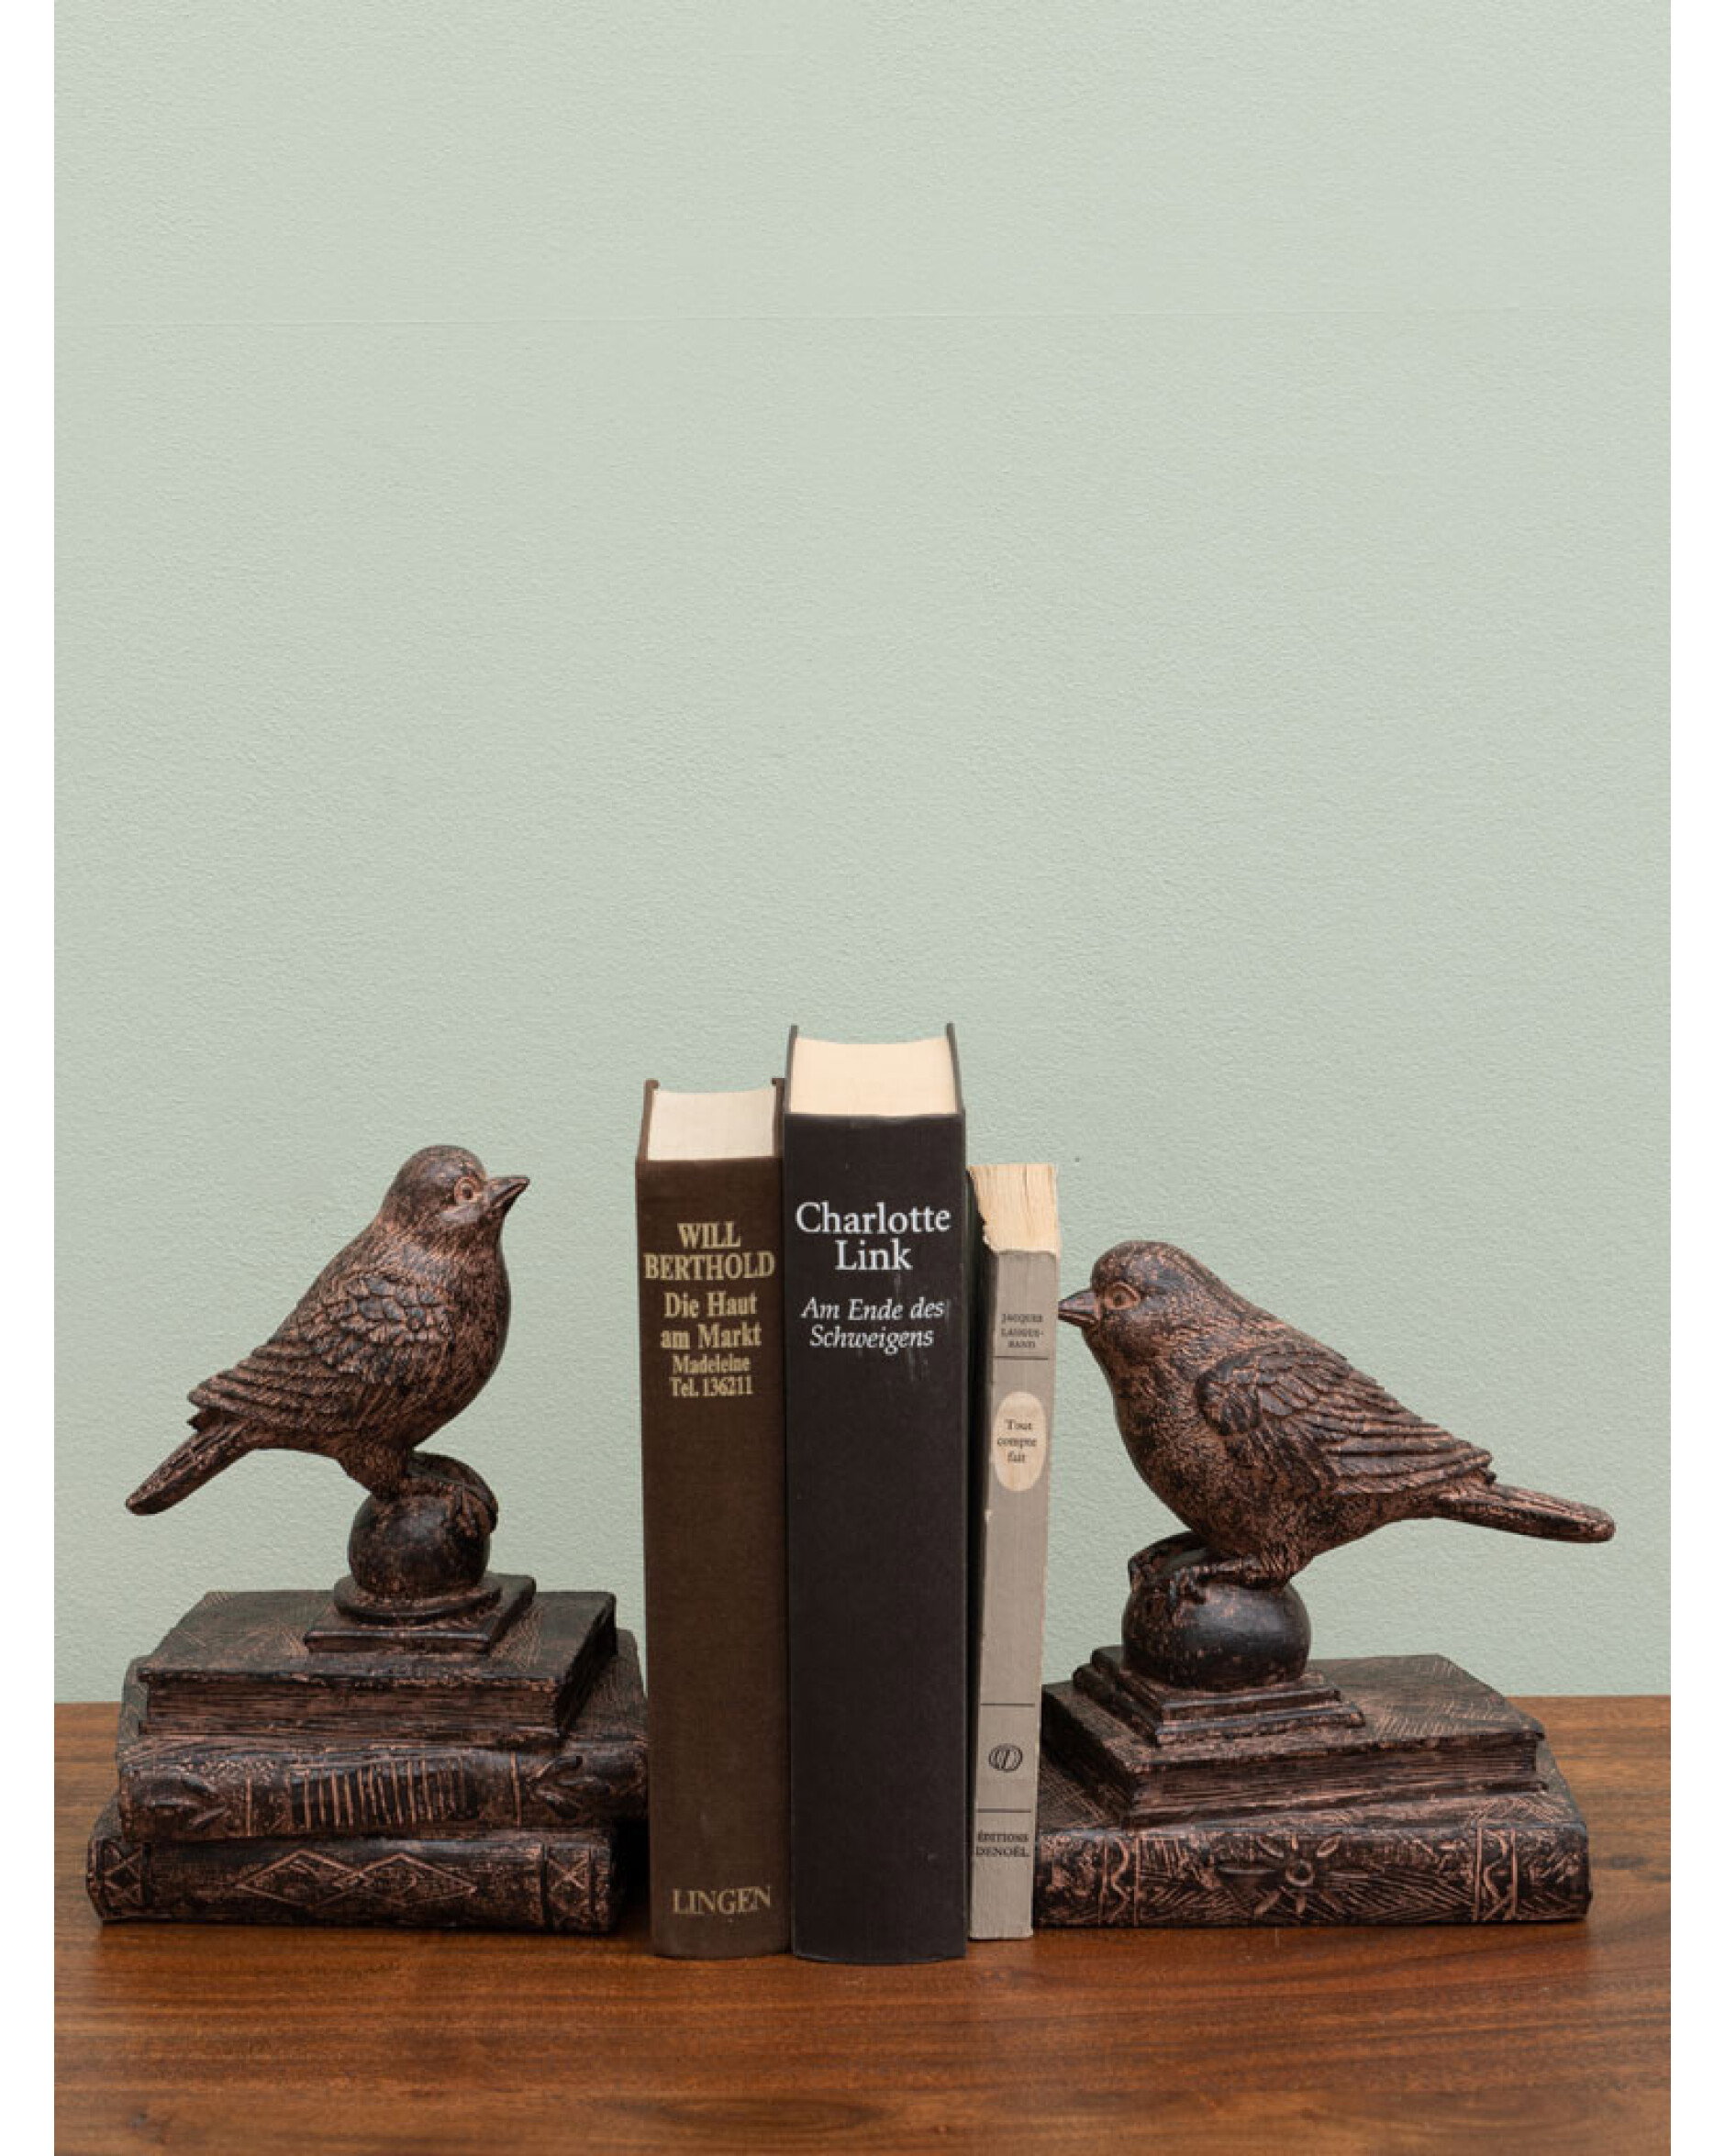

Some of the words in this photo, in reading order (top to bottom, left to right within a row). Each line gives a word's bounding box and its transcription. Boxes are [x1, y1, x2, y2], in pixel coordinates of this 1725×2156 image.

[796, 1200, 952, 1234] Charlotte
[677, 1221, 741, 1250] WILL
[643, 1250, 775, 1280] BERTHOLD
[834, 1238, 914, 1271] Link
[663, 1292, 699, 1318] Die
[706, 1290, 758, 1317] Haut
[800, 1296, 840, 1319] Am
[848, 1297, 904, 1321] Ende
[909, 1296, 945, 1319] des
[660, 1330, 690, 1350] am
[697, 1322, 762, 1349] Markt
[809, 1324, 935, 1356] Schweigens
[672, 1353, 751, 1374] Madeleine
[673, 1885, 772, 1915] LINGEN
